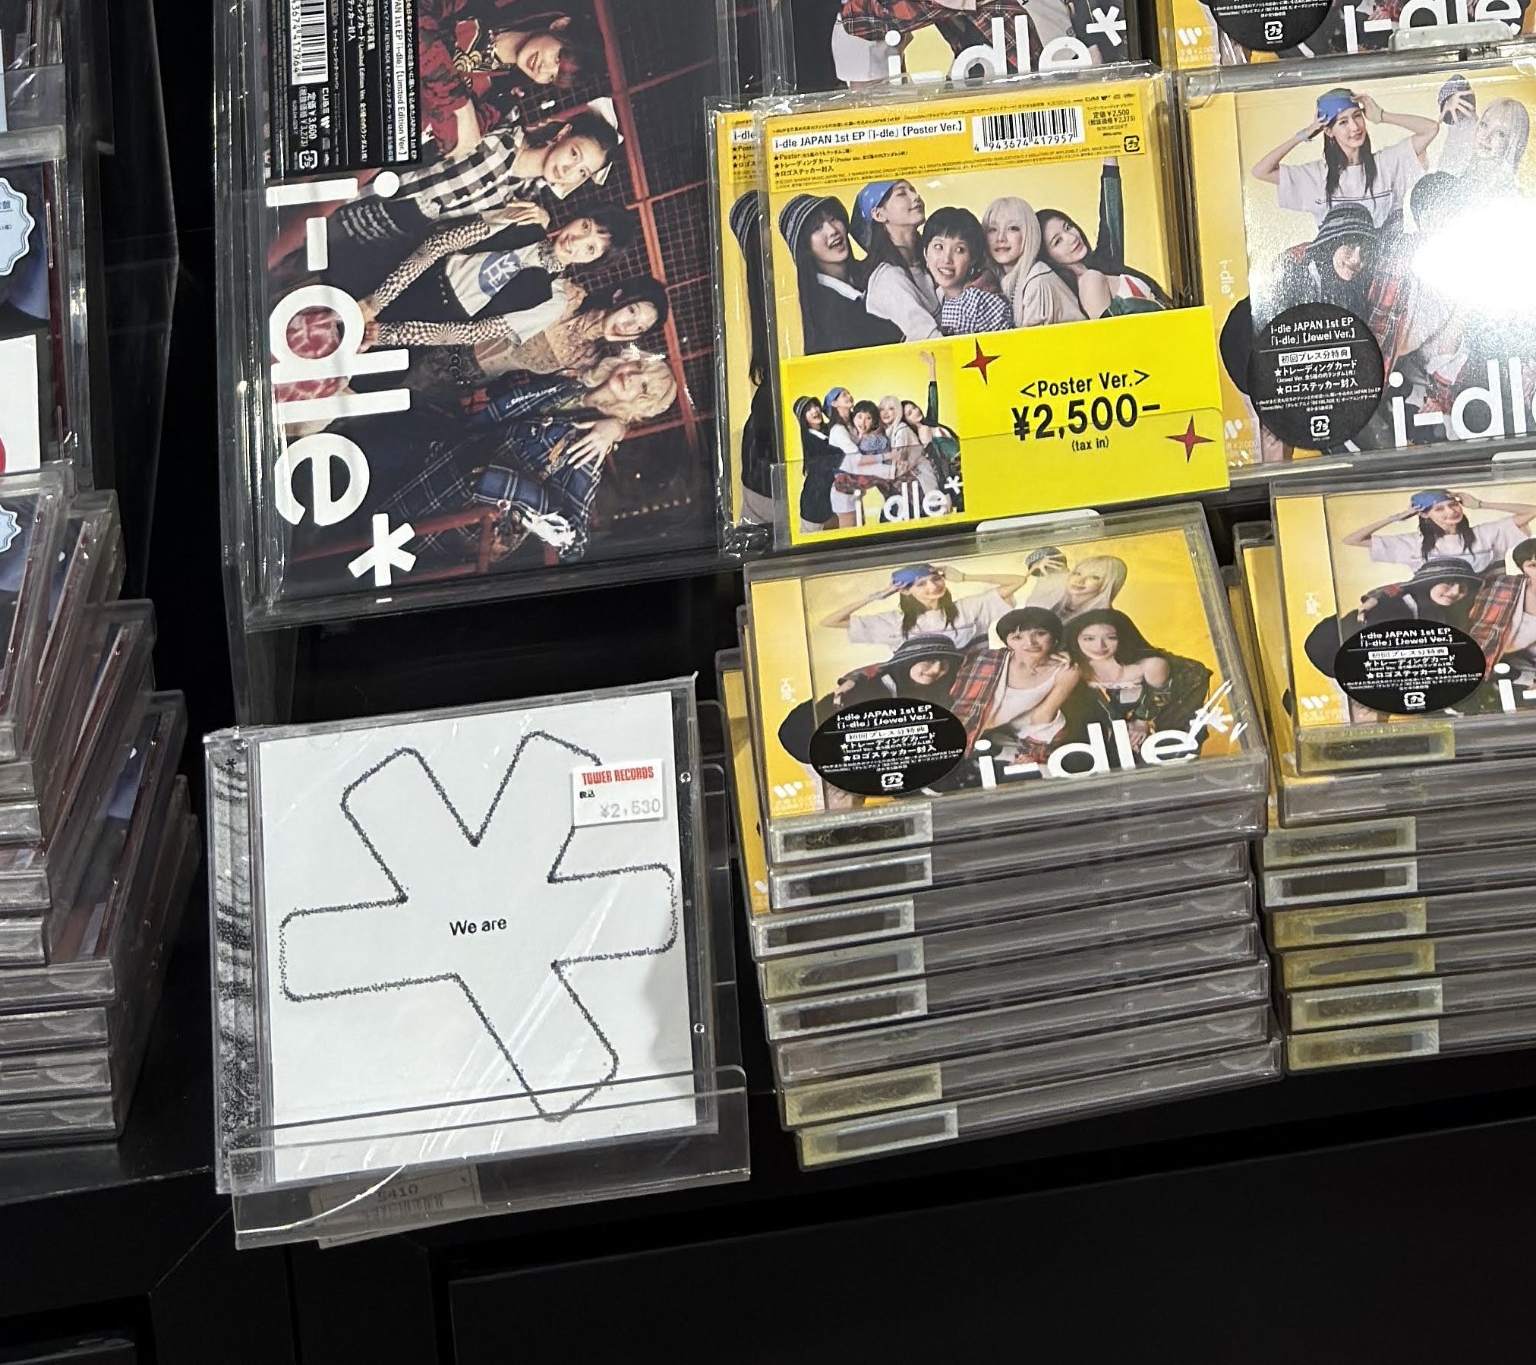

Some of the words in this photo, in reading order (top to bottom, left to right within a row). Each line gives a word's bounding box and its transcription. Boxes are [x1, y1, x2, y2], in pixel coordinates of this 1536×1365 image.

[800, 135, 832, 147] JAPAN
[835, 133, 850, 144] 1st
[853, 132, 865, 142] EP
[1294, 320, 1323, 332] JAPAN
[1326, 319, 1339, 328] 1st
[1341, 317, 1353, 326] EP
[1071, 437, 1091, 453] (tax
[1094, 436, 1109, 451] in)
[581, 770, 611, 786] TOWER
[613, 766, 655, 783] RECORDS
[600, 798, 661, 818] ¥2,530
[450, 920, 477, 936] We
[482, 918, 508, 933] are
